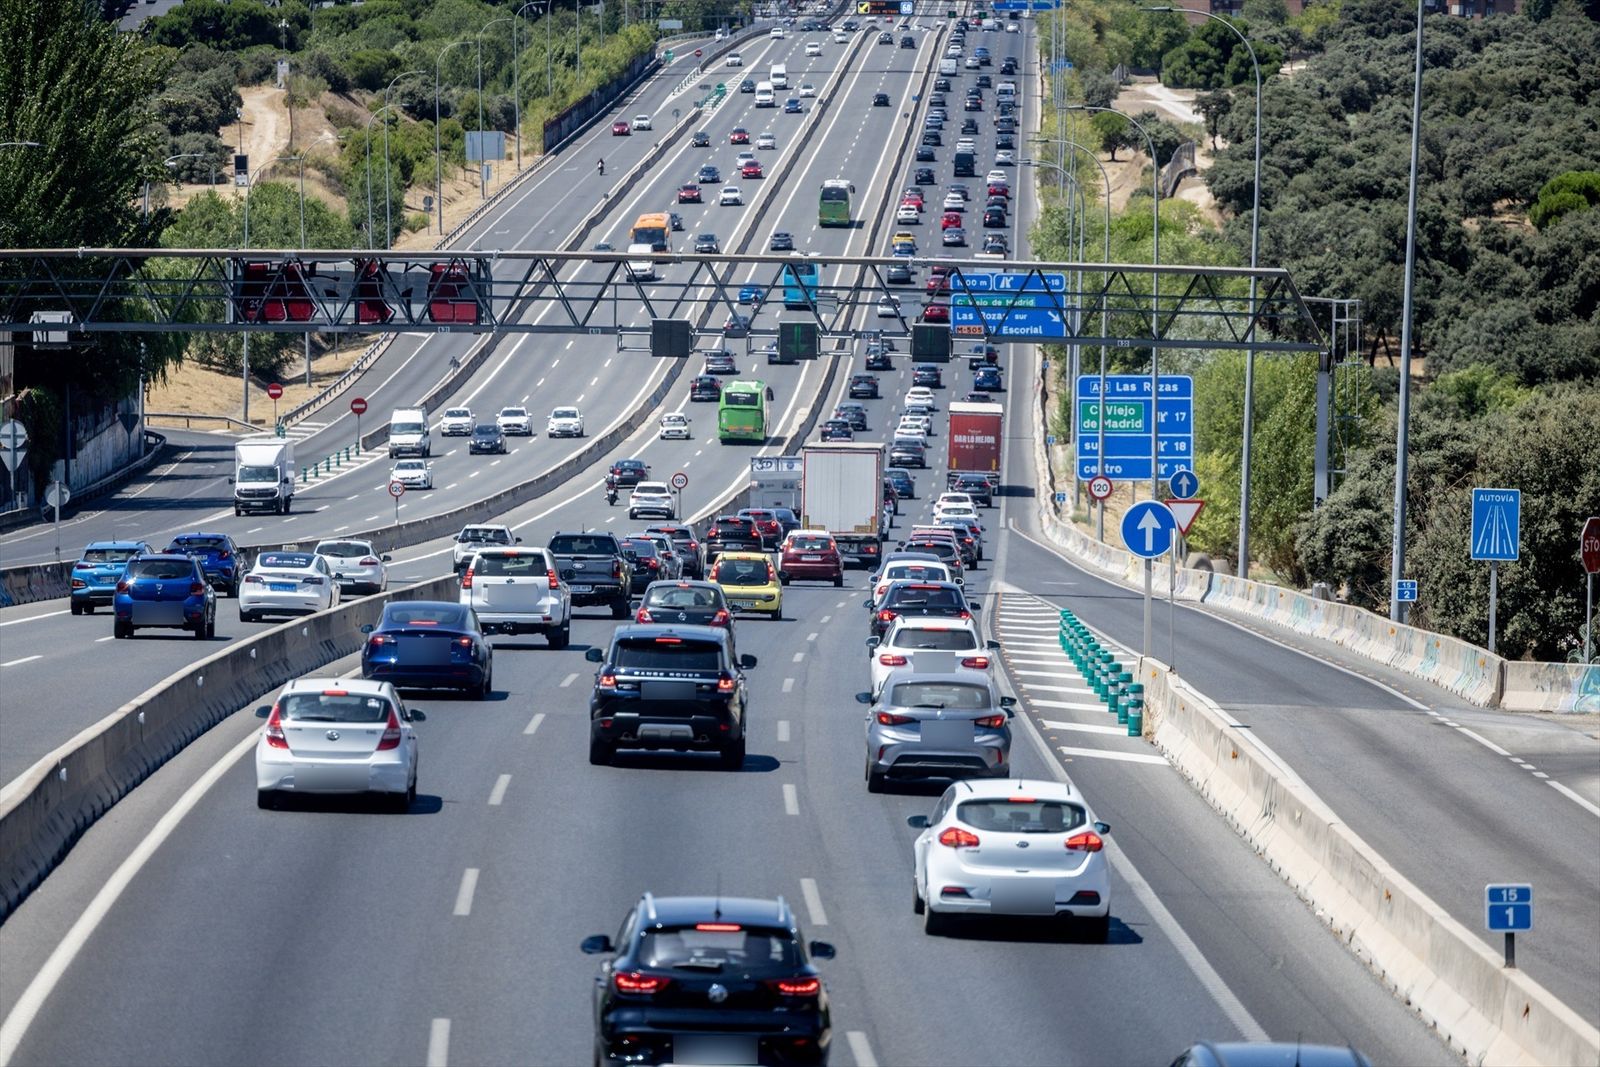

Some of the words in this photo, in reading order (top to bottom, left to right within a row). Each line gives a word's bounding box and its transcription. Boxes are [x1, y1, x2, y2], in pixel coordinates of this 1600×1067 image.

[956, 312, 974, 320] Las
[956, 326, 983, 334] M-505
[1002, 325, 1043, 335] Escorial
[1116, 382, 1137, 392] Las
[1105, 405, 1136, 417] Viejo
[1174, 412, 1187, 421] 17
[1083, 419, 1098, 429] de
[1103, 419, 1143, 429] Madrid
[1084, 442, 1099, 450] su
[1174, 441, 1187, 451] 18
[1083, 463, 1123, 474] cetro
[1093, 484, 1109, 492] 120
[1584, 540, 1600, 552] STO
[1403, 590, 1411, 599] 2
[1501, 888, 1518, 902] 15
[1505, 906, 1514, 927] 1
